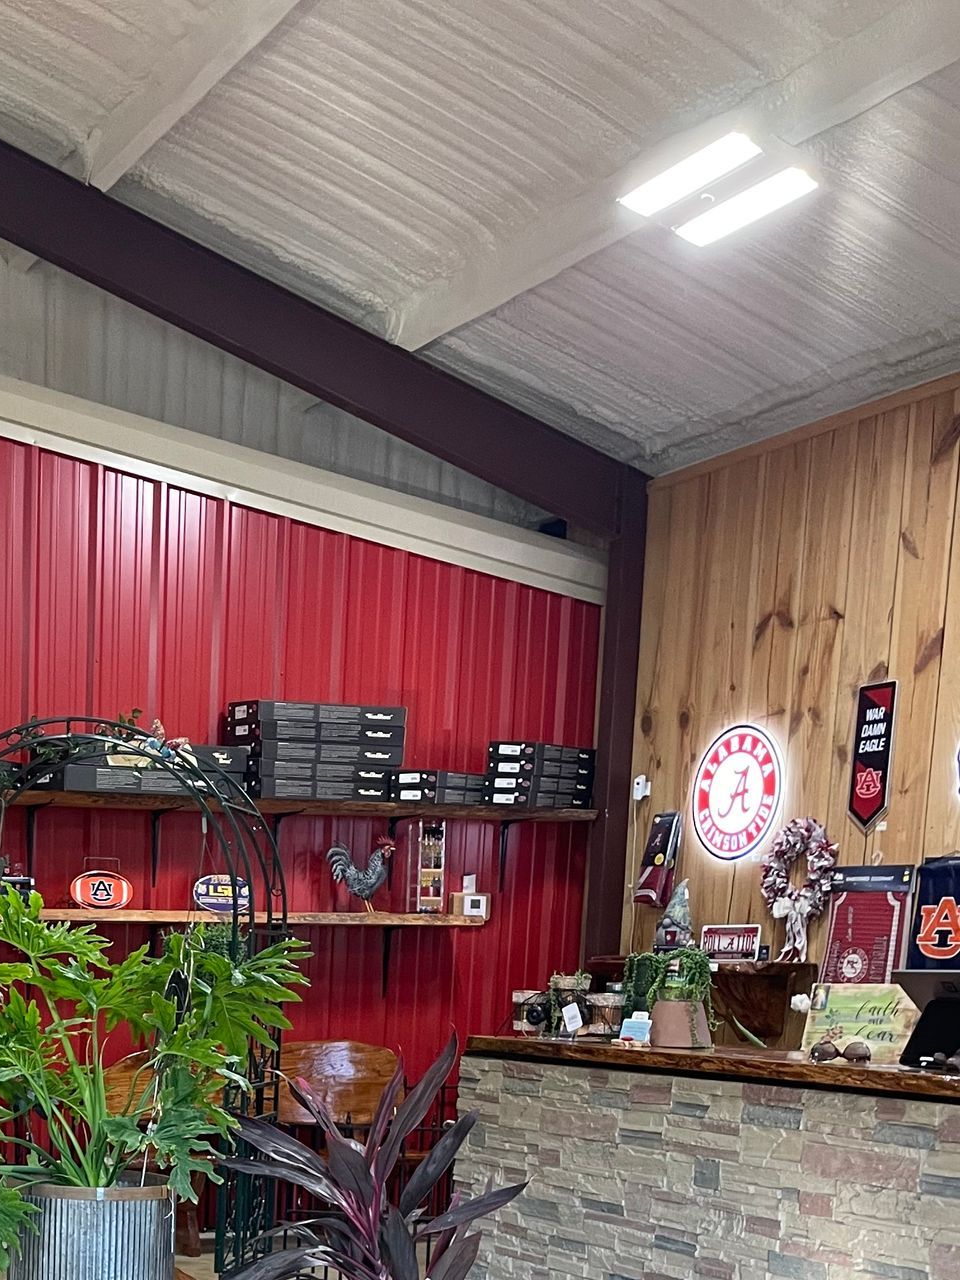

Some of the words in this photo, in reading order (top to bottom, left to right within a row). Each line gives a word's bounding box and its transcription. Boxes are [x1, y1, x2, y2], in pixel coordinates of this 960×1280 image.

[865, 707, 886, 722] WAR
[860, 722, 887, 738] DAMN
[858, 738, 887, 754] EAGLE
[700, 735, 775, 792] ALABAMA
[699, 807, 748, 852] CRIMSON
[750, 793, 776, 834] TIDE
[704, 934, 722, 953] ROLL
[736, 934, 758, 952] TIDE
